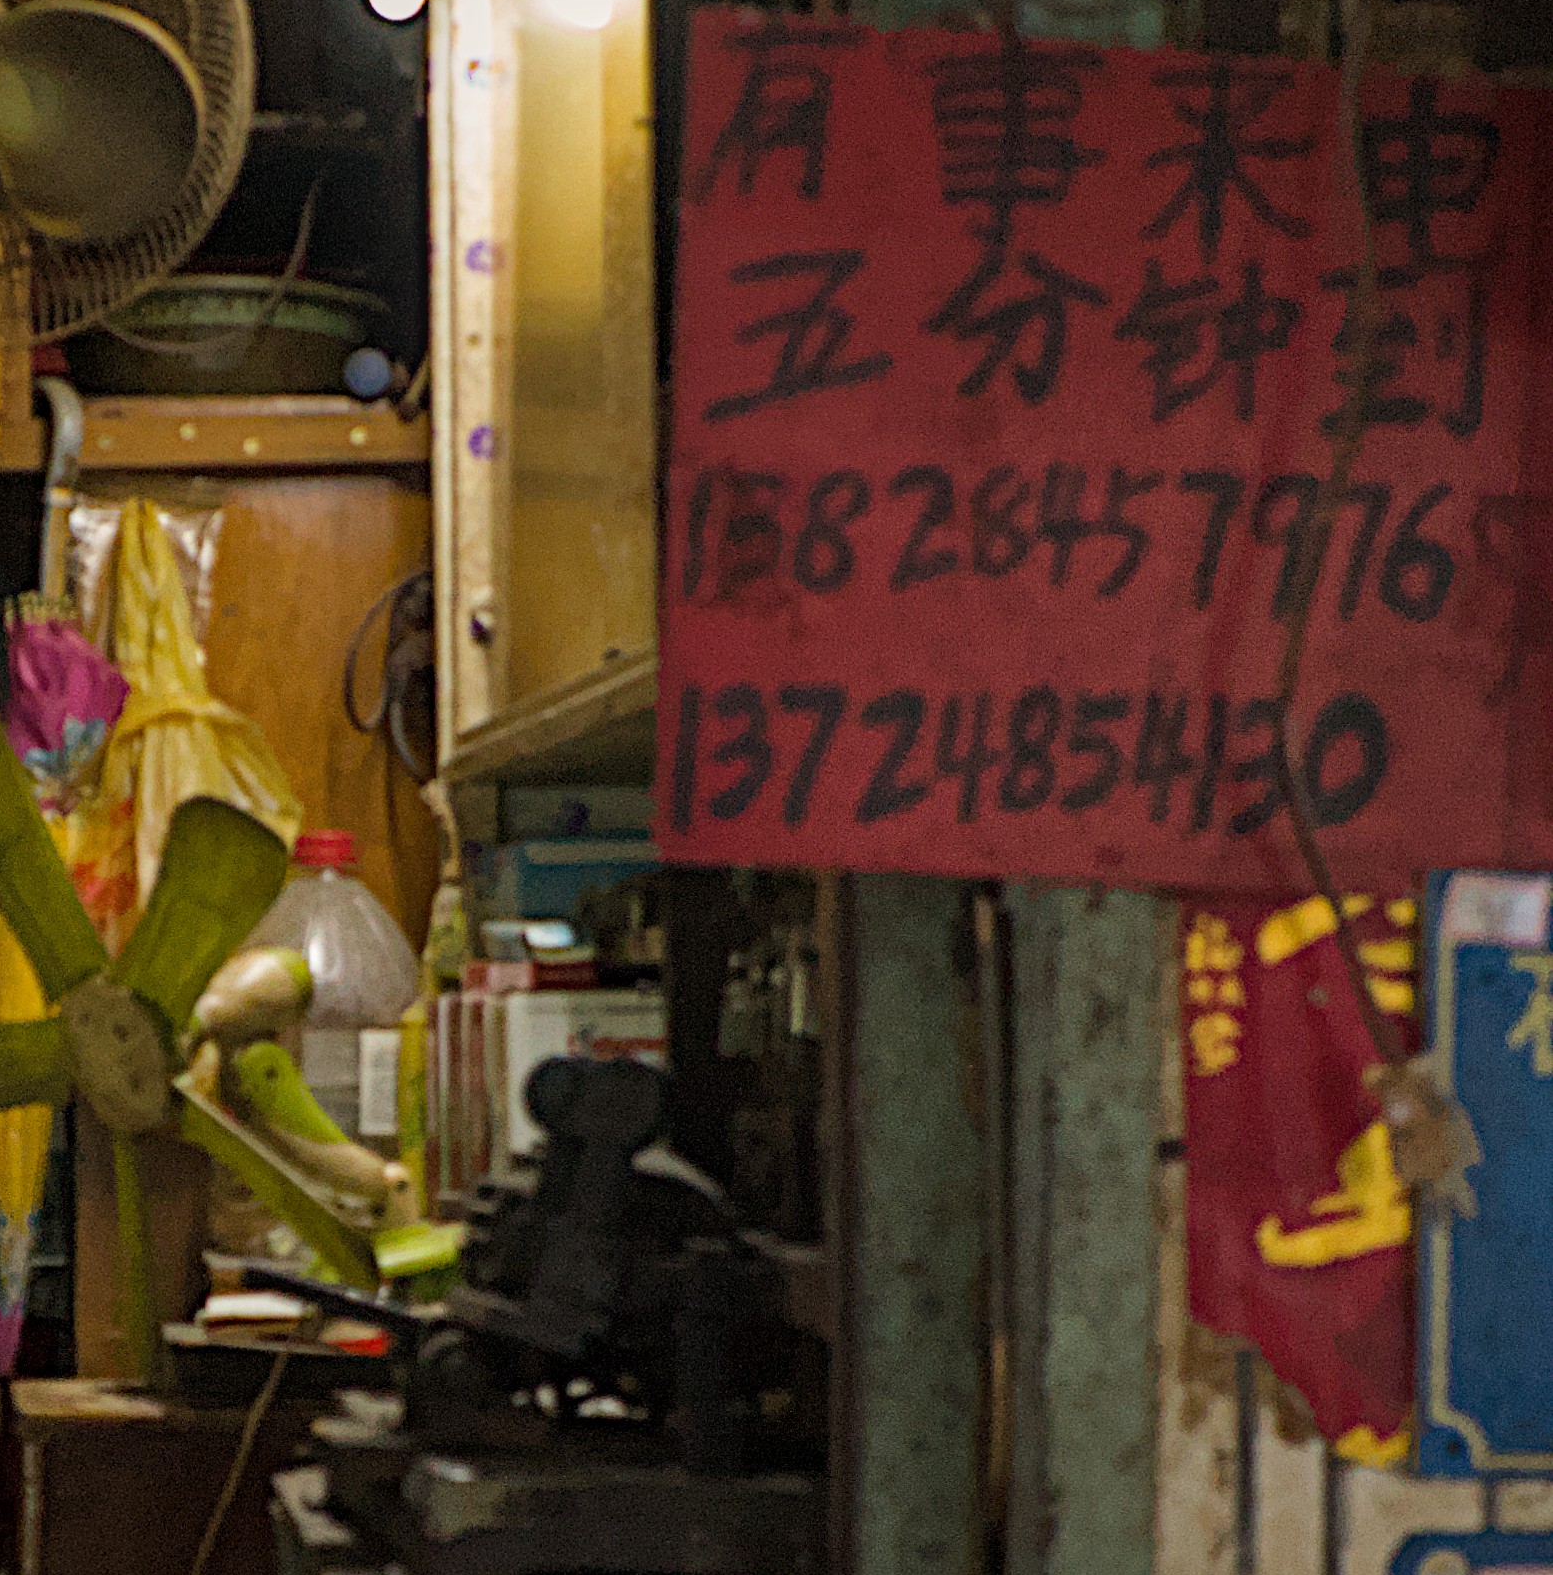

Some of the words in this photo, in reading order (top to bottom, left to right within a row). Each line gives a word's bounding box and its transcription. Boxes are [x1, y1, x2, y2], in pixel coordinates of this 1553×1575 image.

[687, 25, 1508, 271] 有事来电
[702, 239, 1492, 441] 五分钟到
